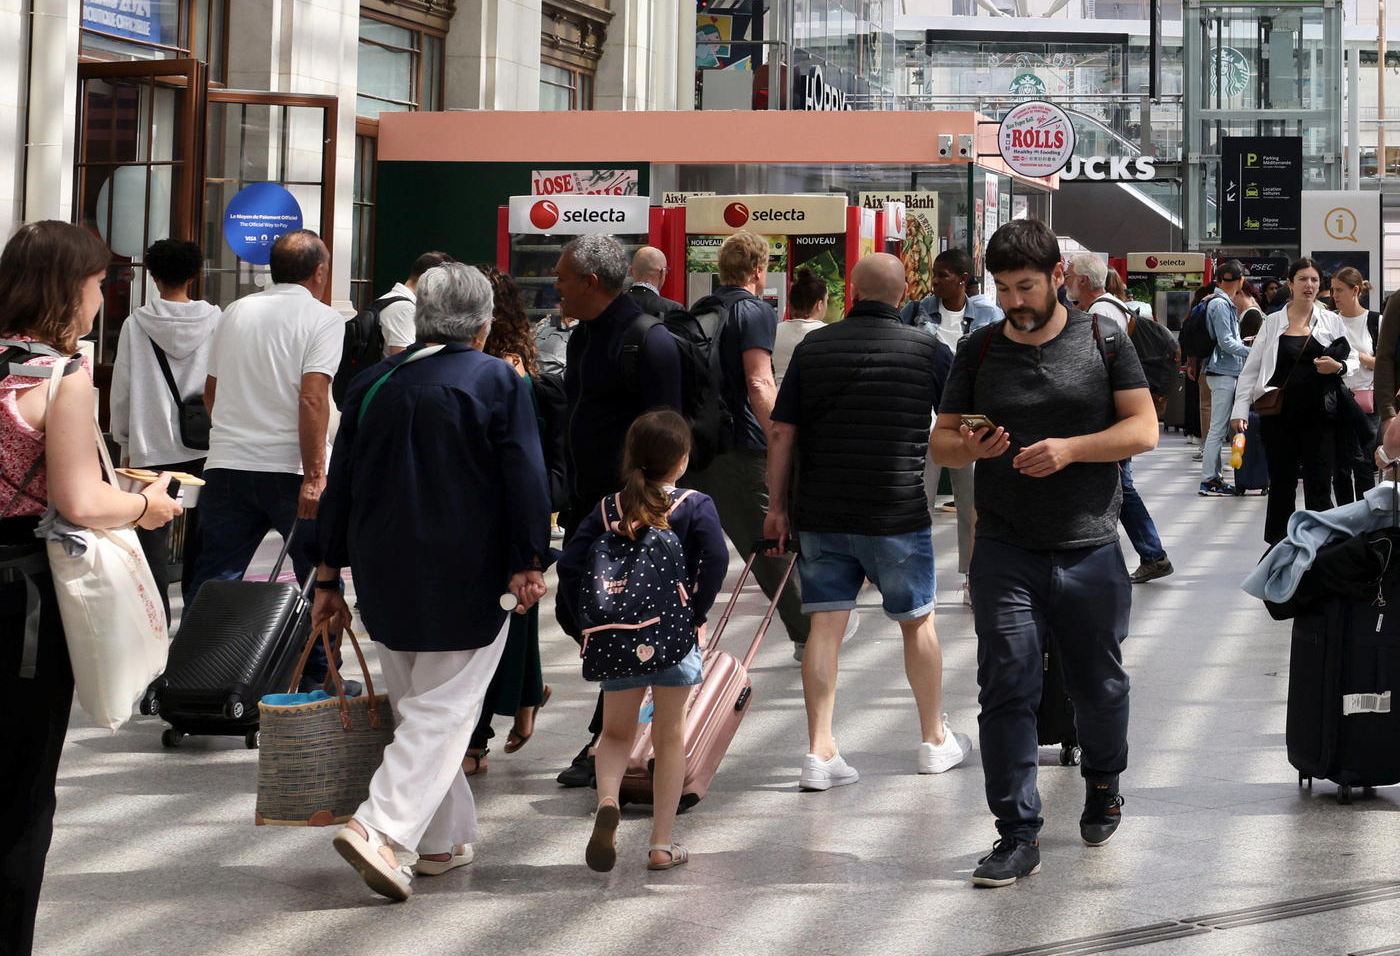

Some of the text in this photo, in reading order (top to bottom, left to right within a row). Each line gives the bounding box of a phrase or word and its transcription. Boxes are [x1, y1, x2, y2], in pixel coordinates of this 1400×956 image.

[534, 174, 574, 196] LOSE
[562, 208, 625, 222] selecta
[752, 208, 805, 221] selecta
[796, 237, 836, 245] NOUVEAU
[1159, 259, 1186, 267] selecta
